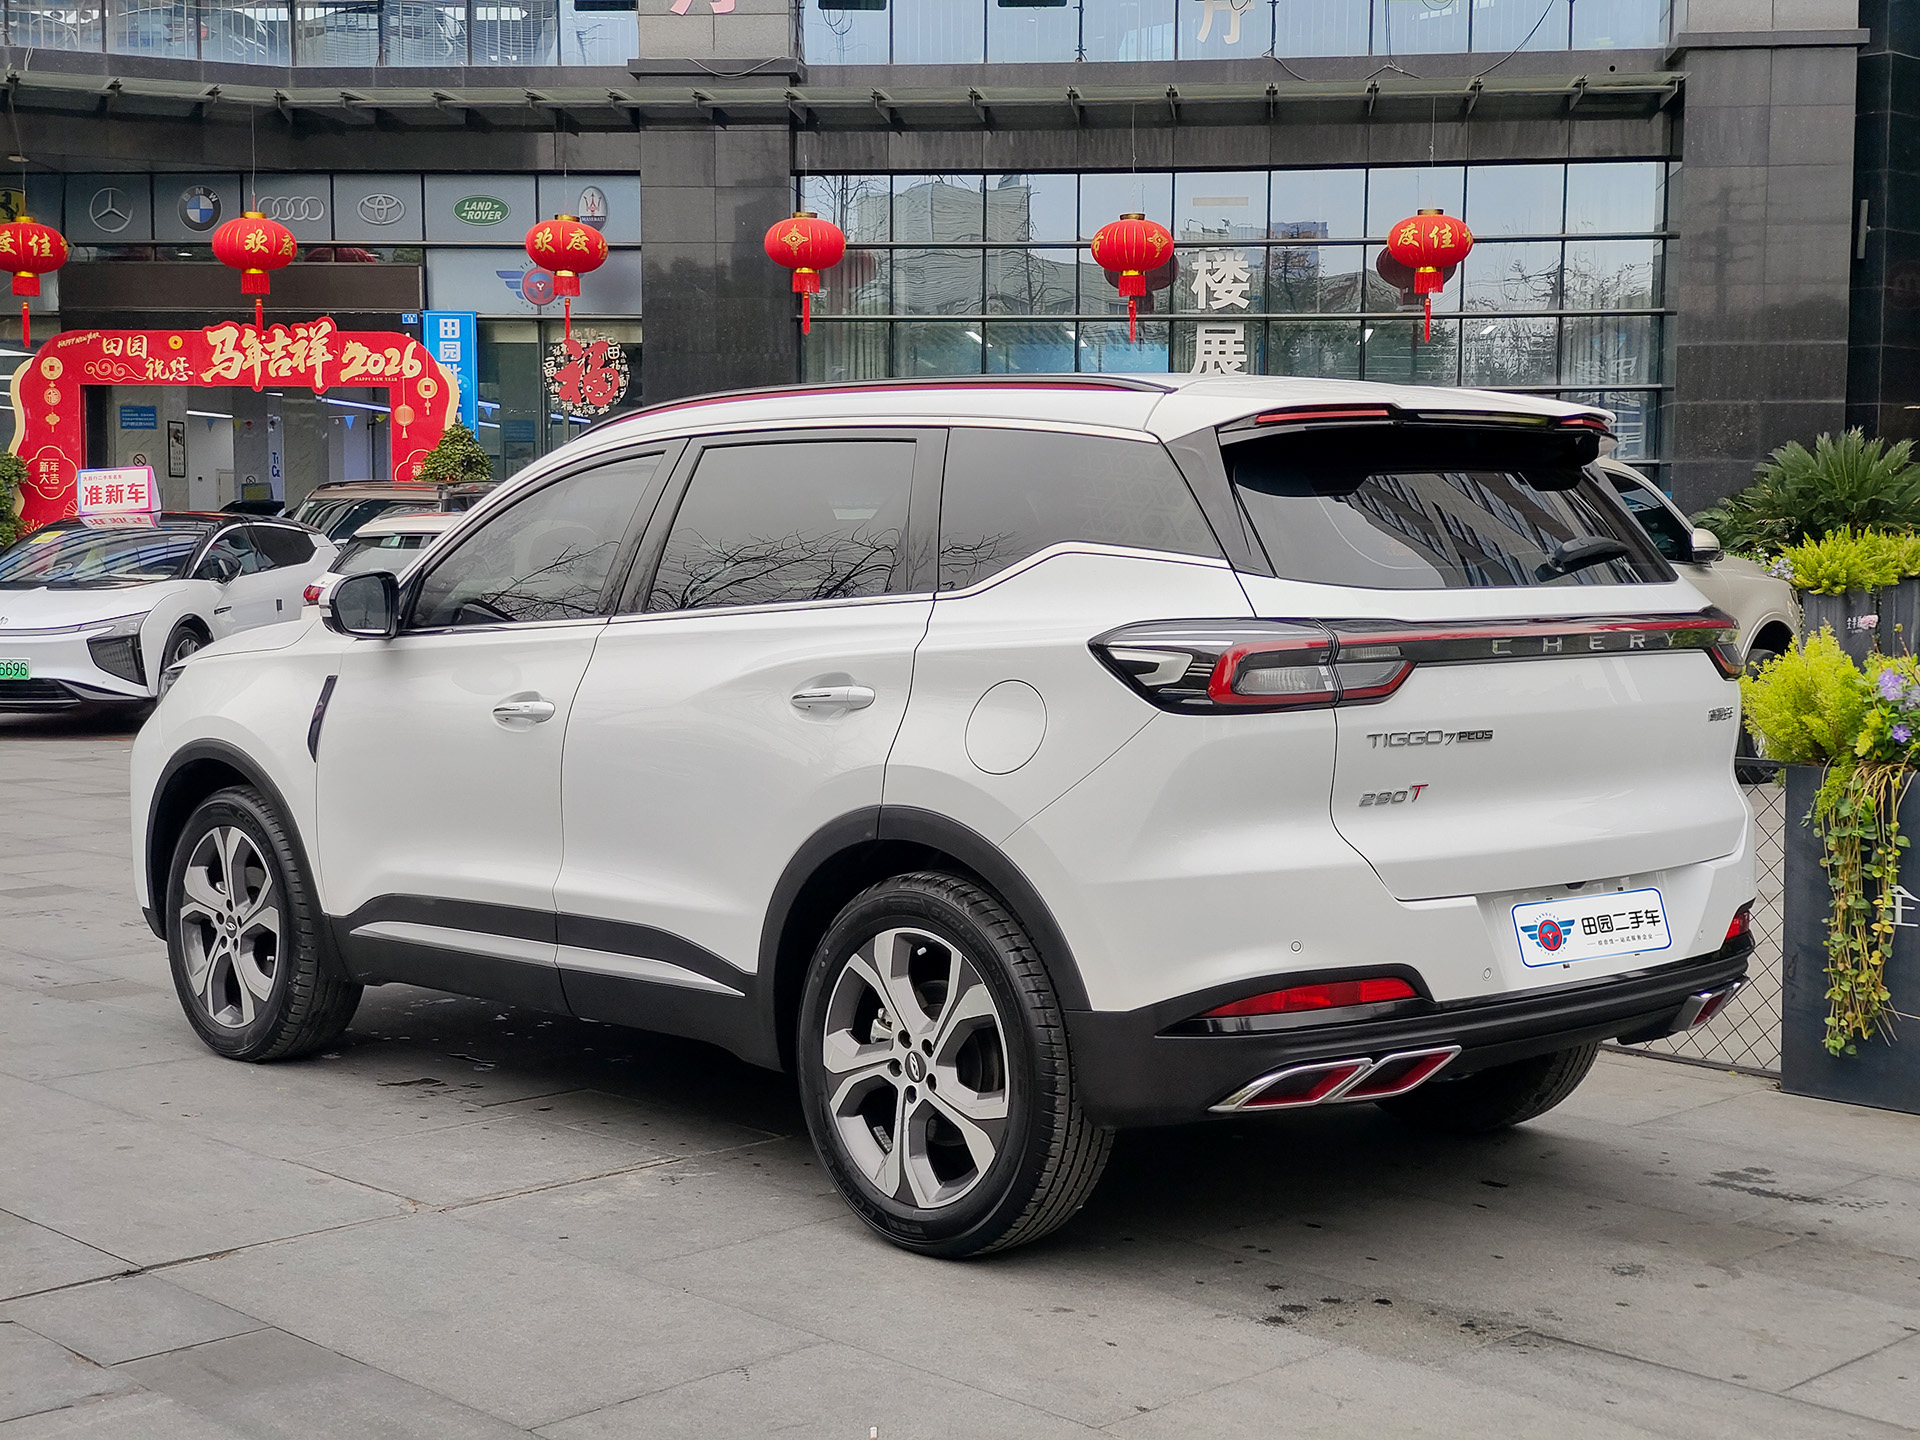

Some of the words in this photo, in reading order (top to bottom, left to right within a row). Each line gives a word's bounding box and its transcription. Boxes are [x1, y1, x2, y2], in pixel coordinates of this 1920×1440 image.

[182, 187, 219, 202] BMW
[463, 201, 492, 211] LAND
[466, 210, 502, 220] ROVER
[244, 228, 294, 258] 欢度
[102, 335, 148, 359] 田园
[201, 321, 338, 389] 马年吉祥
[145, 356, 194, 381] 祝您
[340, 341, 422, 382] 2026
[39, 461, 60, 472] 新年
[39, 473, 60, 485] 大吉
[84, 483, 146, 506] 准新车
[1491, 632, 1677, 656] CHERY
[1367, 730, 1443, 749] TIGGO
[1358, 783, 1430, 808] 290T
[1581, 909, 1661, 936] 田园二手车
